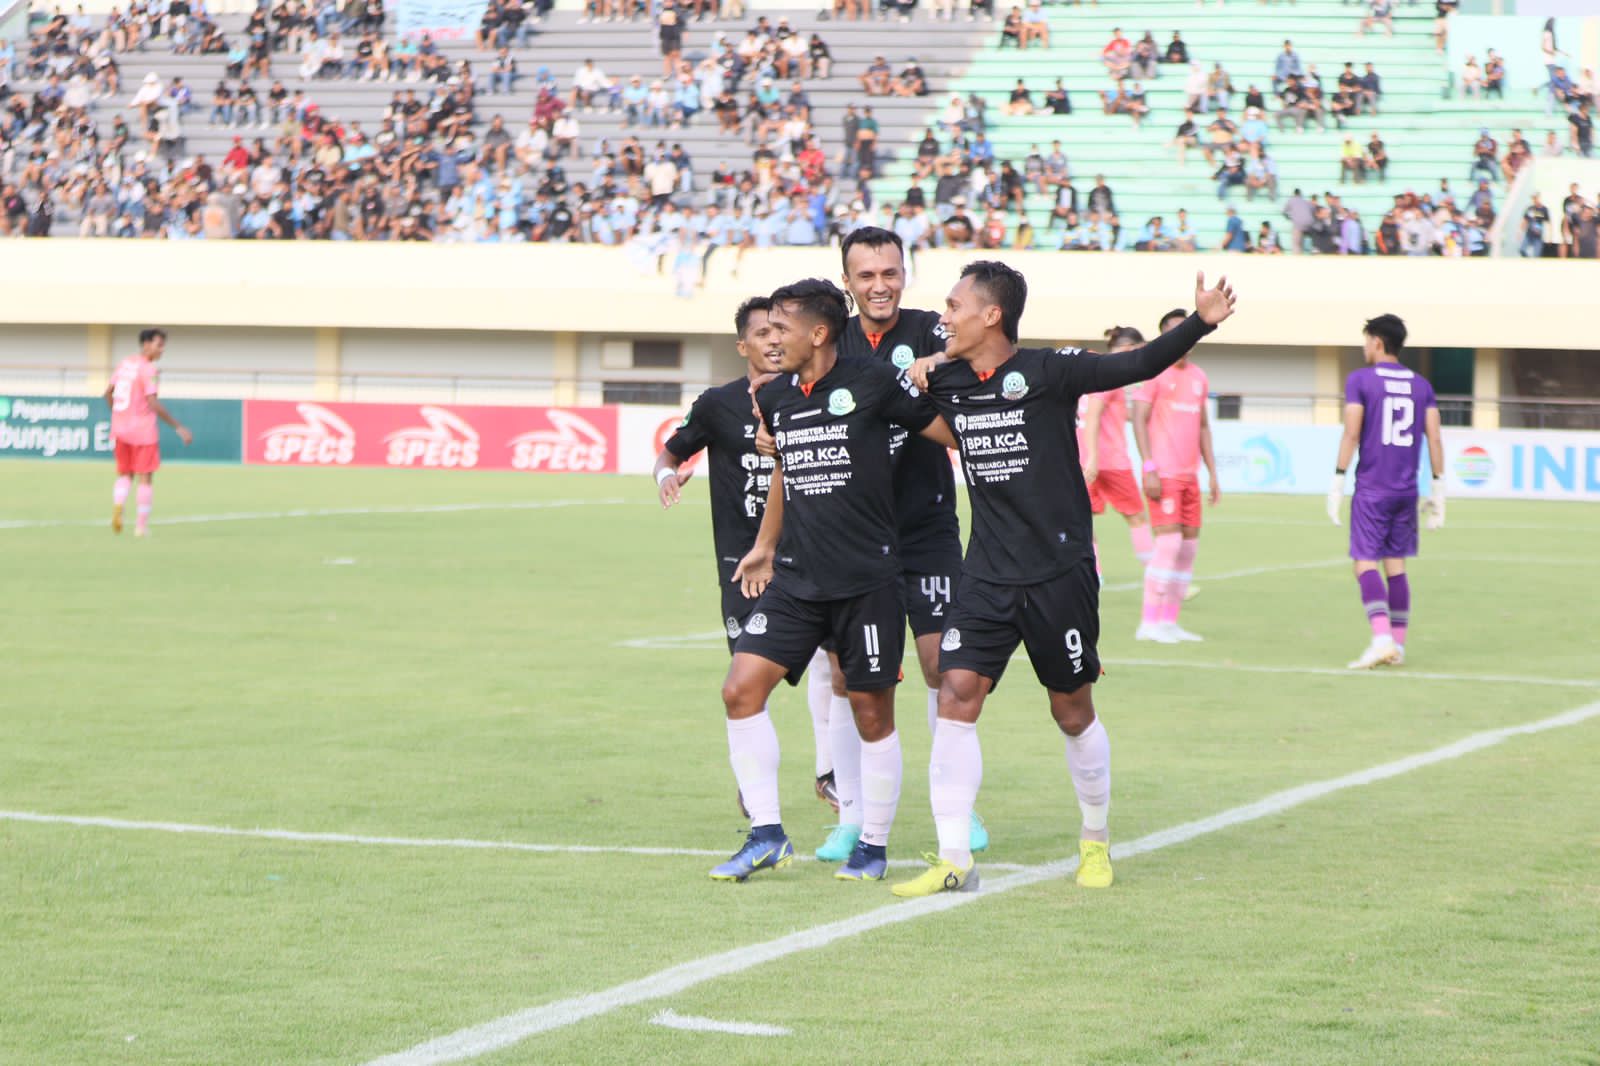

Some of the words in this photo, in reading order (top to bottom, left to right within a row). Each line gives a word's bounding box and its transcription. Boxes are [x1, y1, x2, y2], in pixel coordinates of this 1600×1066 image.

[12, 399, 89, 422] Pegadaian
[967, 413, 1001, 423] MONSTER
[1002, 410, 1025, 420] LAUT
[1382, 396, 1415, 446] 12
[94, 421, 116, 451] E
[786, 426, 824, 439] MONSTER
[825, 425, 849, 433] LAUT
[966, 436, 992, 450] BPR
[994, 432, 1028, 448] KCA
[263, 436, 355, 464] SPECS
[386, 439, 480, 467] SPECS
[512, 443, 608, 471] SPECS
[786, 450, 814, 465] BPR
[817, 446, 850, 460] KCA
[1007, 458, 1030, 467] SEHAT
[830, 471, 853, 481] SEHAT
[920, 576, 950, 603] 44
[864, 624, 880, 656] 11
[1065, 628, 1083, 659] 9
